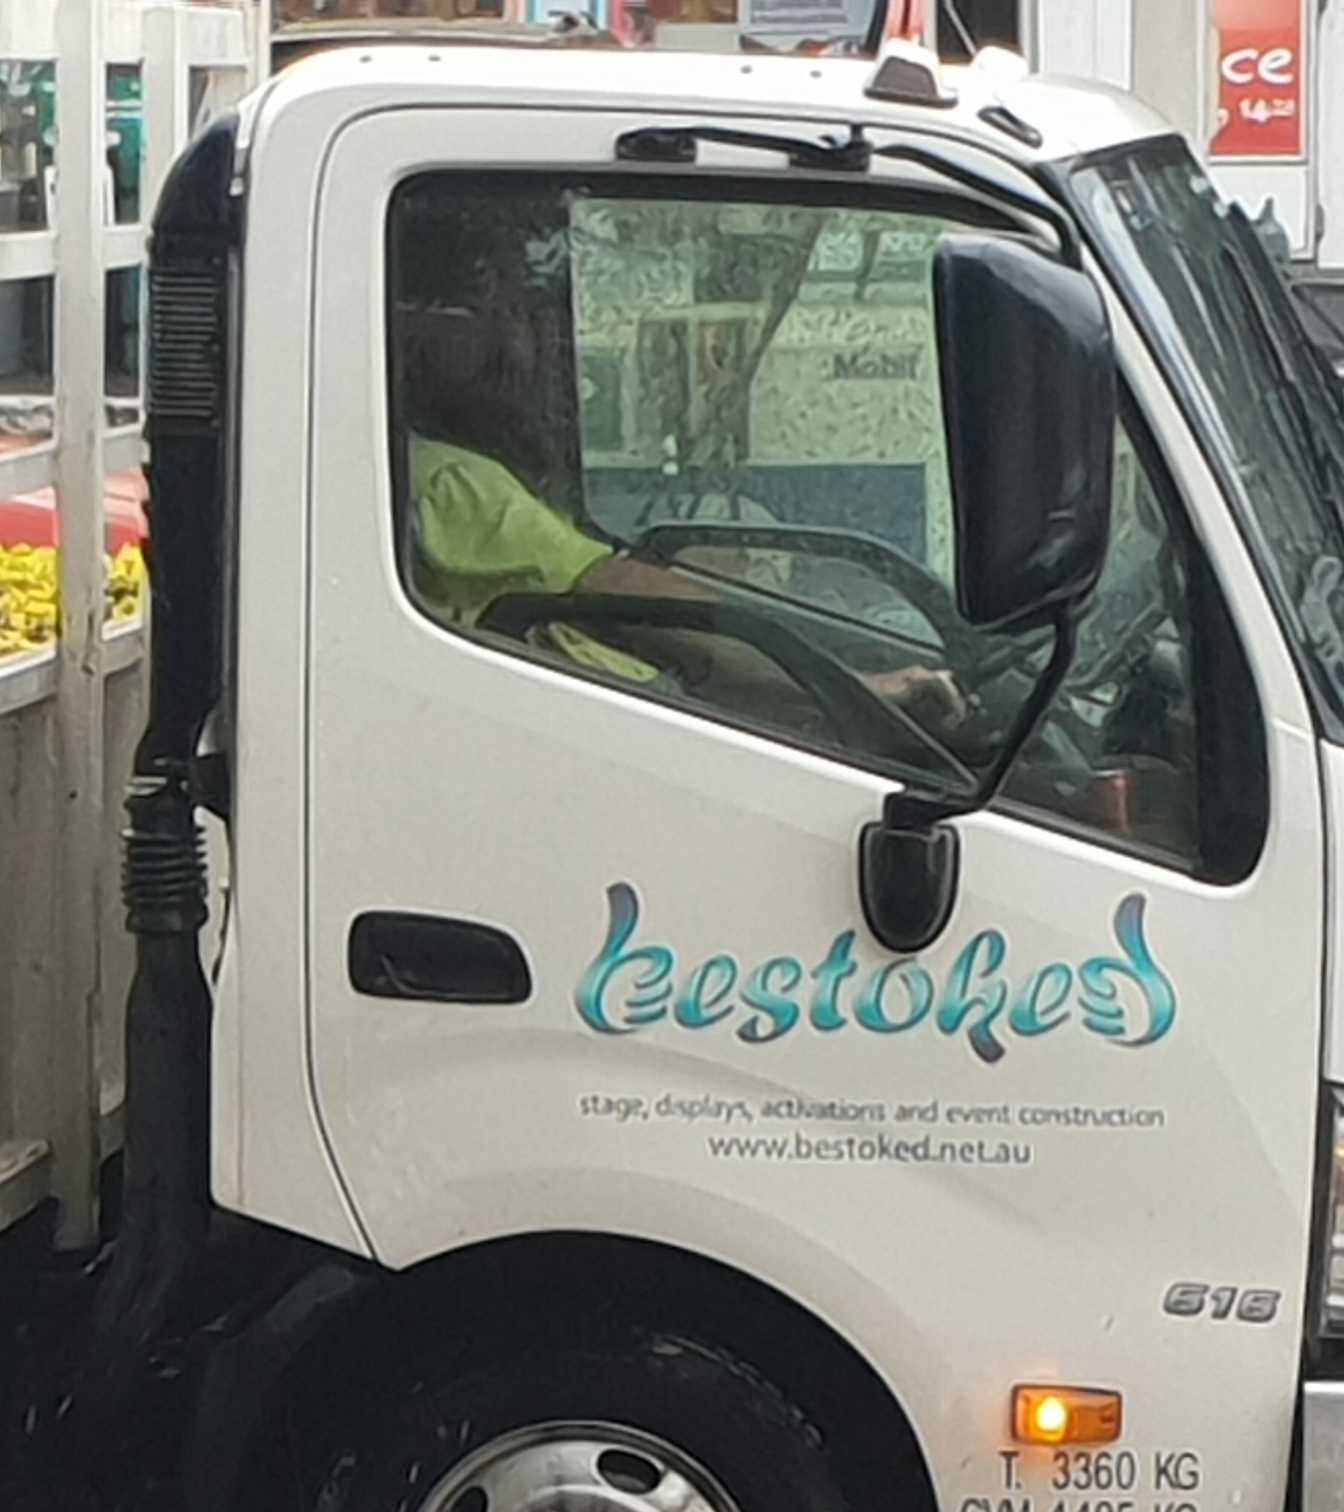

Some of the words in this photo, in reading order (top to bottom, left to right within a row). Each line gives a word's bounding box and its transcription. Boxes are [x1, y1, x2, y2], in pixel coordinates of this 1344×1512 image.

[574, 882, 1177, 1064] bestoked
[580, 1096, 649, 1122] stage,
[656, 1093, 753, 1123] displays,
[760, 1098, 886, 1122] activations
[894, 1101, 939, 1123] and
[946, 1104, 1011, 1125] event
[1018, 1105, 1165, 1128] construction
[708, 1132, 1032, 1165] www.bestoked.net.au
[1163, 1282, 1282, 1323] 616
[1052, 1451, 1136, 1491] 3360
[1154, 1453, 1201, 1491] KG
